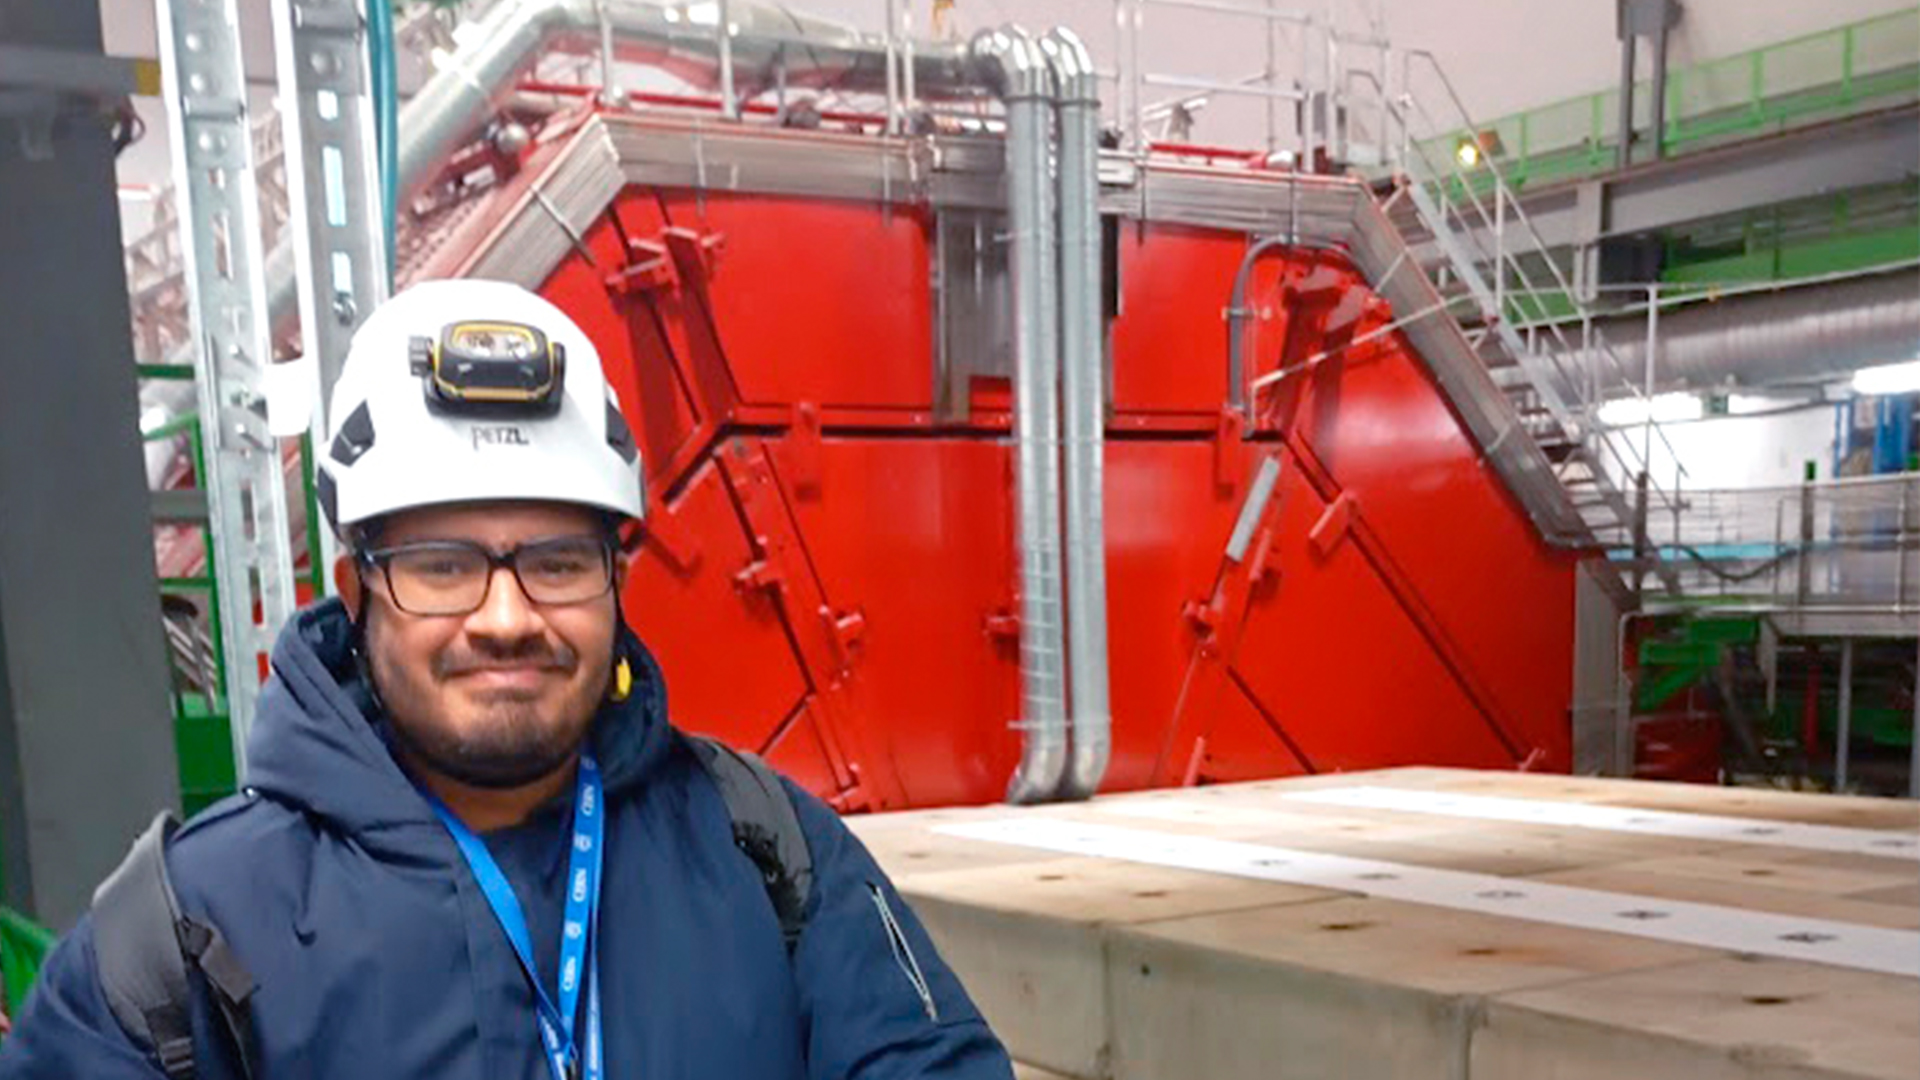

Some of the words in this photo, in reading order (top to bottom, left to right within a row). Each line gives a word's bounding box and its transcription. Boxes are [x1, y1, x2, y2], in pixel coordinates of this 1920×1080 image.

[581, 784, 595, 816] CERN
[573, 868, 587, 902] CERN
[563, 956, 576, 991] CERN
